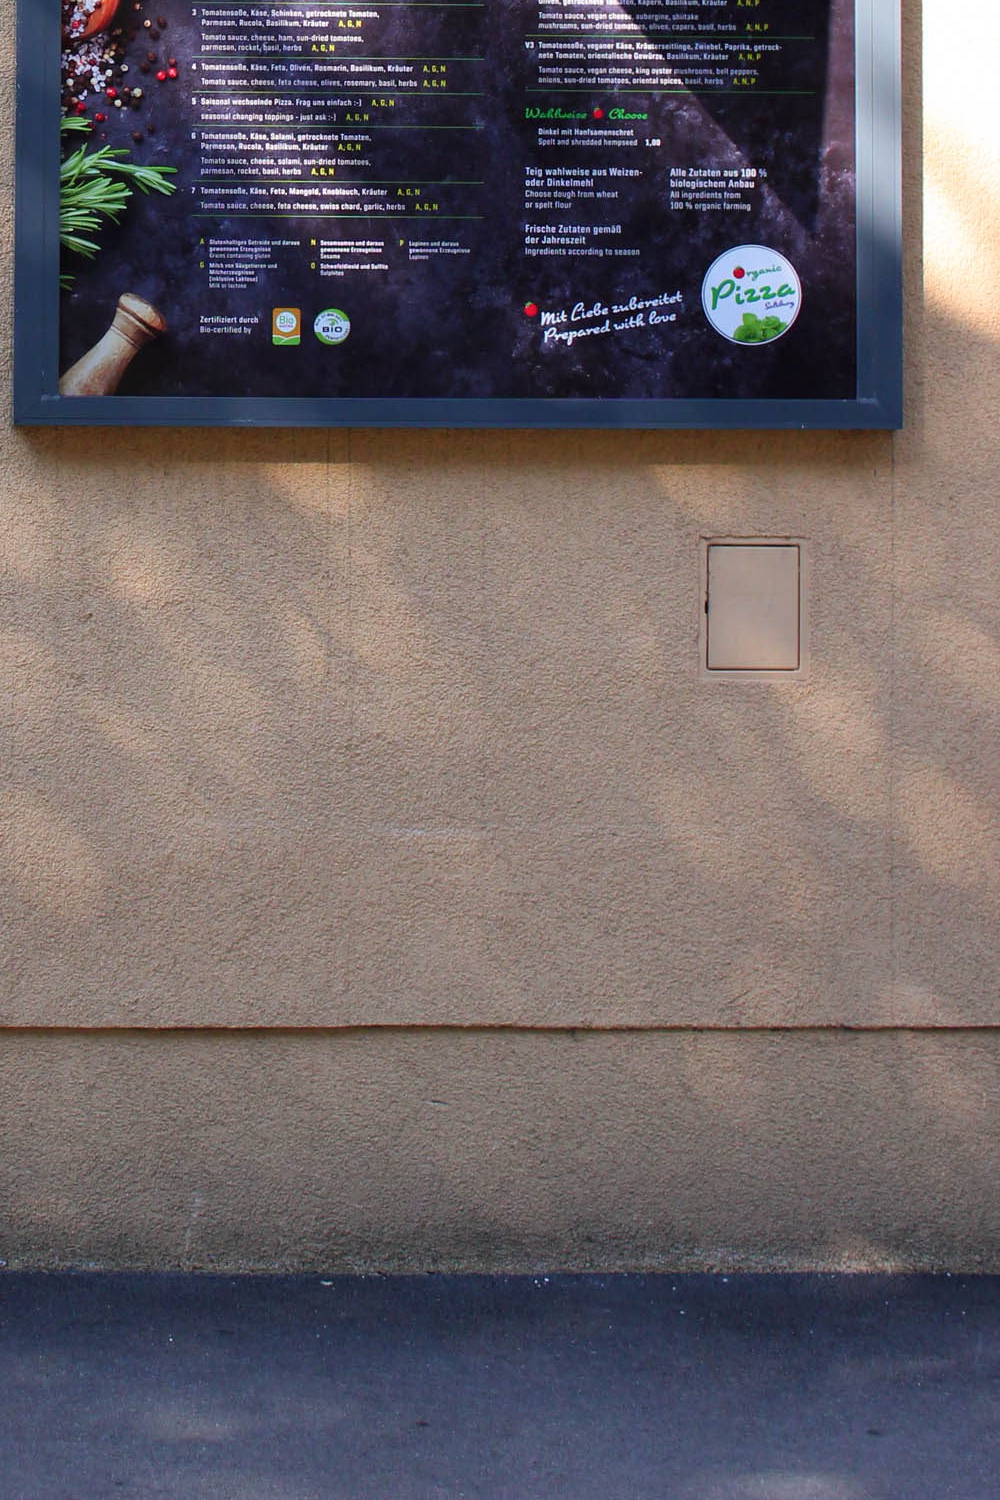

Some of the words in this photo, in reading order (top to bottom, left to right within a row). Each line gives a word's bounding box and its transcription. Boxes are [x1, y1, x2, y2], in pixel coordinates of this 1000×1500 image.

[608, 108, 648, 120] Choose
[525, 167, 543, 178] Teig
[544, 168, 590, 177] wahlweise
[608, 168, 643, 177] Weizen-
[670, 168, 687, 177] Alle
[688, 168, 722, 177] Zutaten
[723, 170, 739, 178] aus
[740, 168, 758, 178] 100
[525, 178, 545, 187] oder
[546, 178, 594, 187] Dinkelmehl
[670, 179, 727, 190] biologischem
[728, 180, 754, 189] Anbau
[525, 225, 556, 234] Frische
[557, 225, 591, 234] Zutaten
[592, 225, 621, 236] gemäß
[525, 236, 540, 244] der
[541, 236, 586, 245] Jahreszeit
[711, 279, 796, 310] Pizza
[540, 311, 567, 327] Mit
[570, 302, 609, 322] Liebe
[611, 290, 683, 314] zubereitet
[200, 316, 238, 324] Zertifiziert
[239, 316, 259, 324] durch
[200, 326, 242, 334] Bio-certified
[243, 326, 252, 336] by
[543, 319, 611, 346] Prepared
[613, 313, 645, 331] with
[648, 310, 677, 325] love
